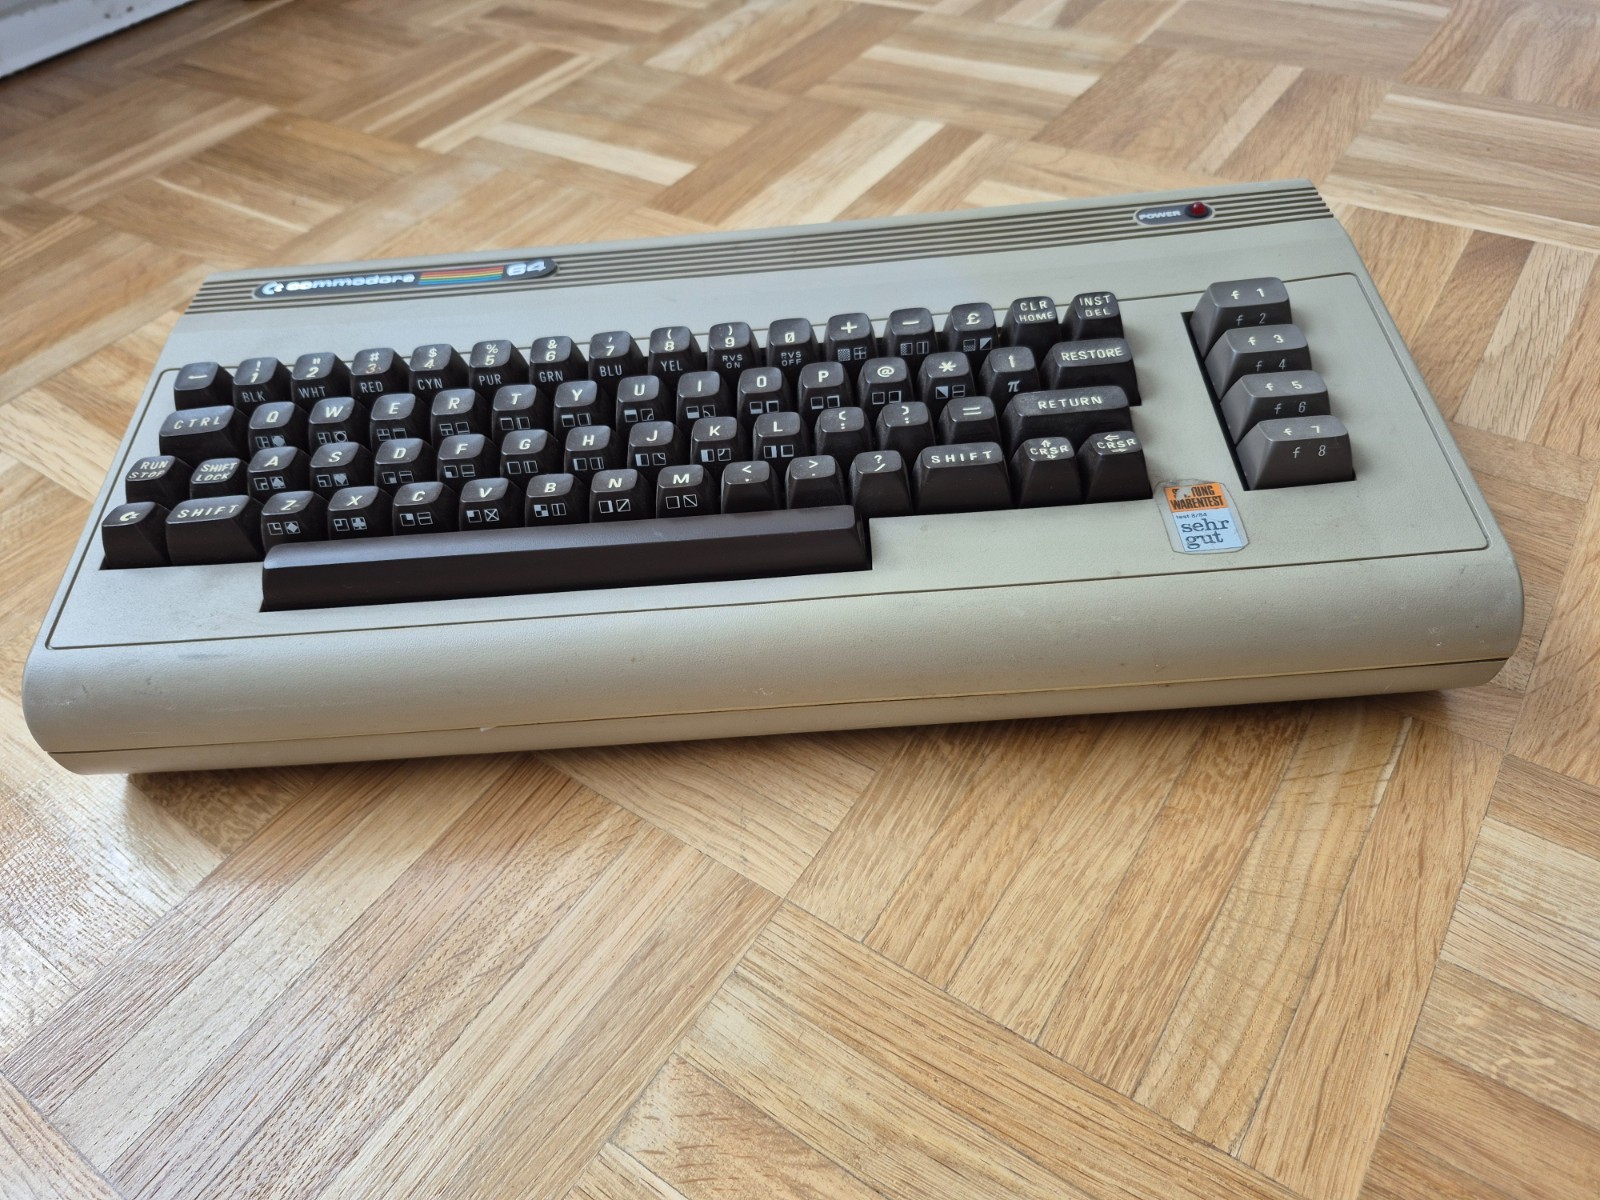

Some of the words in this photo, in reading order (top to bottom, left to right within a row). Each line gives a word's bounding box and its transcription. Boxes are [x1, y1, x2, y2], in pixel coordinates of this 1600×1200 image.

[1138, 210, 1182, 220] POWER
[286, 273, 416, 292] commodore
[506, 260, 547, 276] 64
[1079, 295, 1112, 306] INST
[1020, 301, 1048, 312] CLR
[1018, 311, 1055, 322] HOME
[1085, 308, 1111, 317] DEL
[966, 312, 981, 326] £
[841, 321, 858, 334] +
[548, 339, 558, 349] &
[664, 341, 675, 351] 8
[724, 337, 736, 348] 9
[429, 348, 438, 358] $
[486, 344, 499, 354] %
[605, 346, 615, 356] 7
[1061, 347, 1124, 361] RESTORE
[369, 351, 380, 362] #
[485, 355, 496, 366] 5
[545, 351, 556, 362] 6
[722, 354, 743, 362] RVS
[780, 351, 802, 359] RVS
[424, 360, 435, 369] 4
[660, 360, 683, 372] YEL
[726, 361, 741, 369] ON
[781, 358, 802, 366] OFF
[306, 367, 319, 378] 2
[366, 363, 377, 374] 3
[599, 365, 623, 377] BLU
[877, 366, 895, 378] @
[478, 374, 502, 386] PUR
[539, 371, 564, 383] GRN
[818, 370, 829, 383] P
[360, 381, 384, 393] RED
[417, 378, 443, 391] CYN
[633, 383, 646, 396] U
[242, 391, 267, 403] BLK
[298, 386, 326, 399] WHT
[572, 389, 583, 401] Y
[448, 398, 460, 409] R
[511, 393, 522, 405] T
[1037, 395, 1103, 410] RETURN
[325, 406, 344, 418] W
[388, 402, 400, 415] E
[266, 411, 279, 423] Q
[173, 416, 221, 430] CTRL
[773, 421, 783, 433] L
[646, 429, 659, 442] J
[709, 425, 721, 437] K
[519, 438, 532, 450] G
[582, 435, 595, 446] H
[1097, 438, 1136, 449] CRSR
[393, 448, 406, 459] D
[456, 443, 468, 455] F
[1029, 444, 1069, 456] CRSR
[266, 456, 279, 467] A
[328, 452, 343, 462] S
[931, 450, 992, 463] SHIFT
[140, 460, 168, 470] RUN
[200, 462, 238, 473] SHIFT
[128, 470, 165, 479] STOP
[196, 472, 232, 482] LOCK
[672, 473, 690, 485] M
[544, 482, 556, 493] B
[608, 477, 623, 488] N
[412, 491, 426, 502] C
[479, 487, 493, 498] V
[281, 500, 296, 511] Z
[347, 495, 363, 505] X
[1170, 495, 1225, 511] WARENTEST
[177, 504, 239, 518] SHIFT
[1181, 518, 1229, 533] sehr
[1185, 530, 1224, 549] gut
